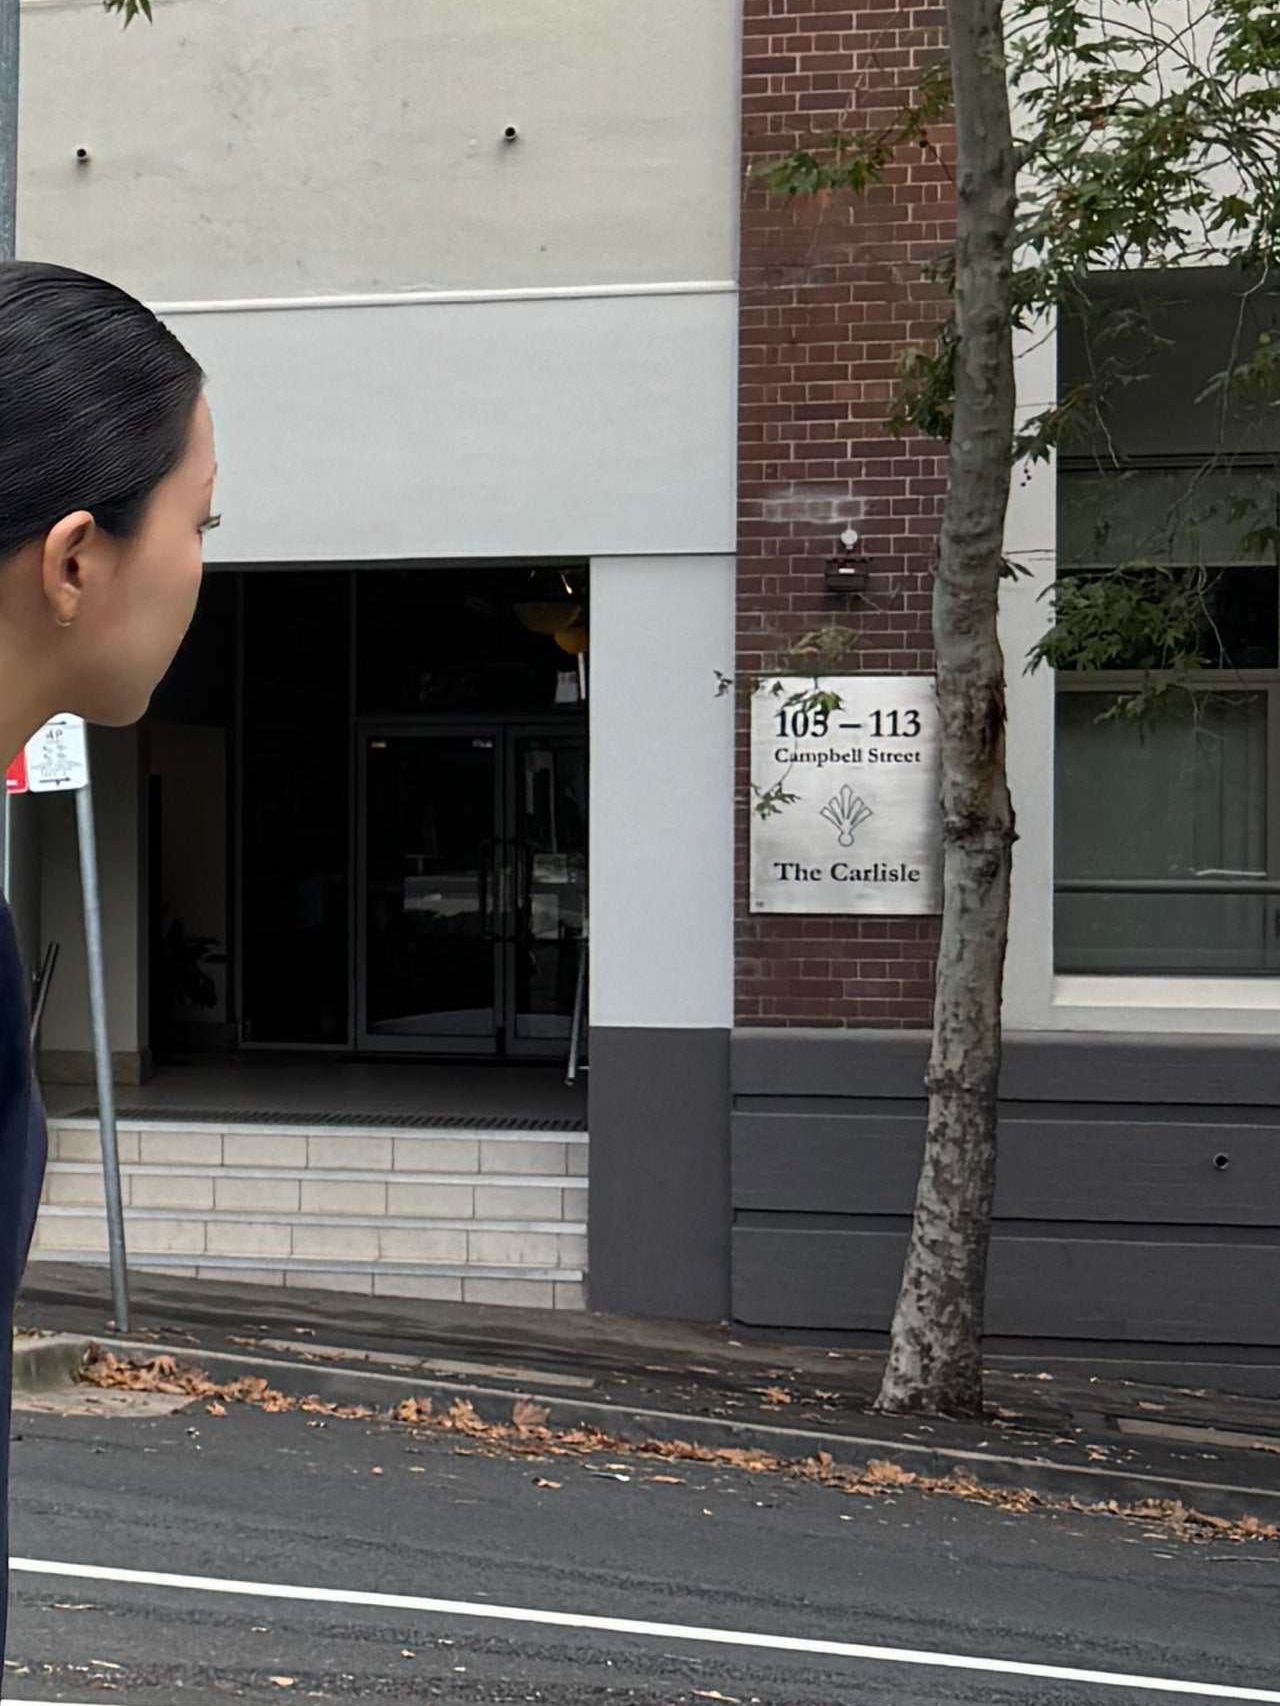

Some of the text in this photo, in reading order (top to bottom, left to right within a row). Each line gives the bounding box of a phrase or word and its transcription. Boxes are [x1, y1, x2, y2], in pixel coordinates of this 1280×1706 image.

[775, 710, 828, 737] 105
[869, 710, 921, 737] 113
[774, 748, 921, 766] Campbell Street
[774, 862, 920, 881] The Carlisle
